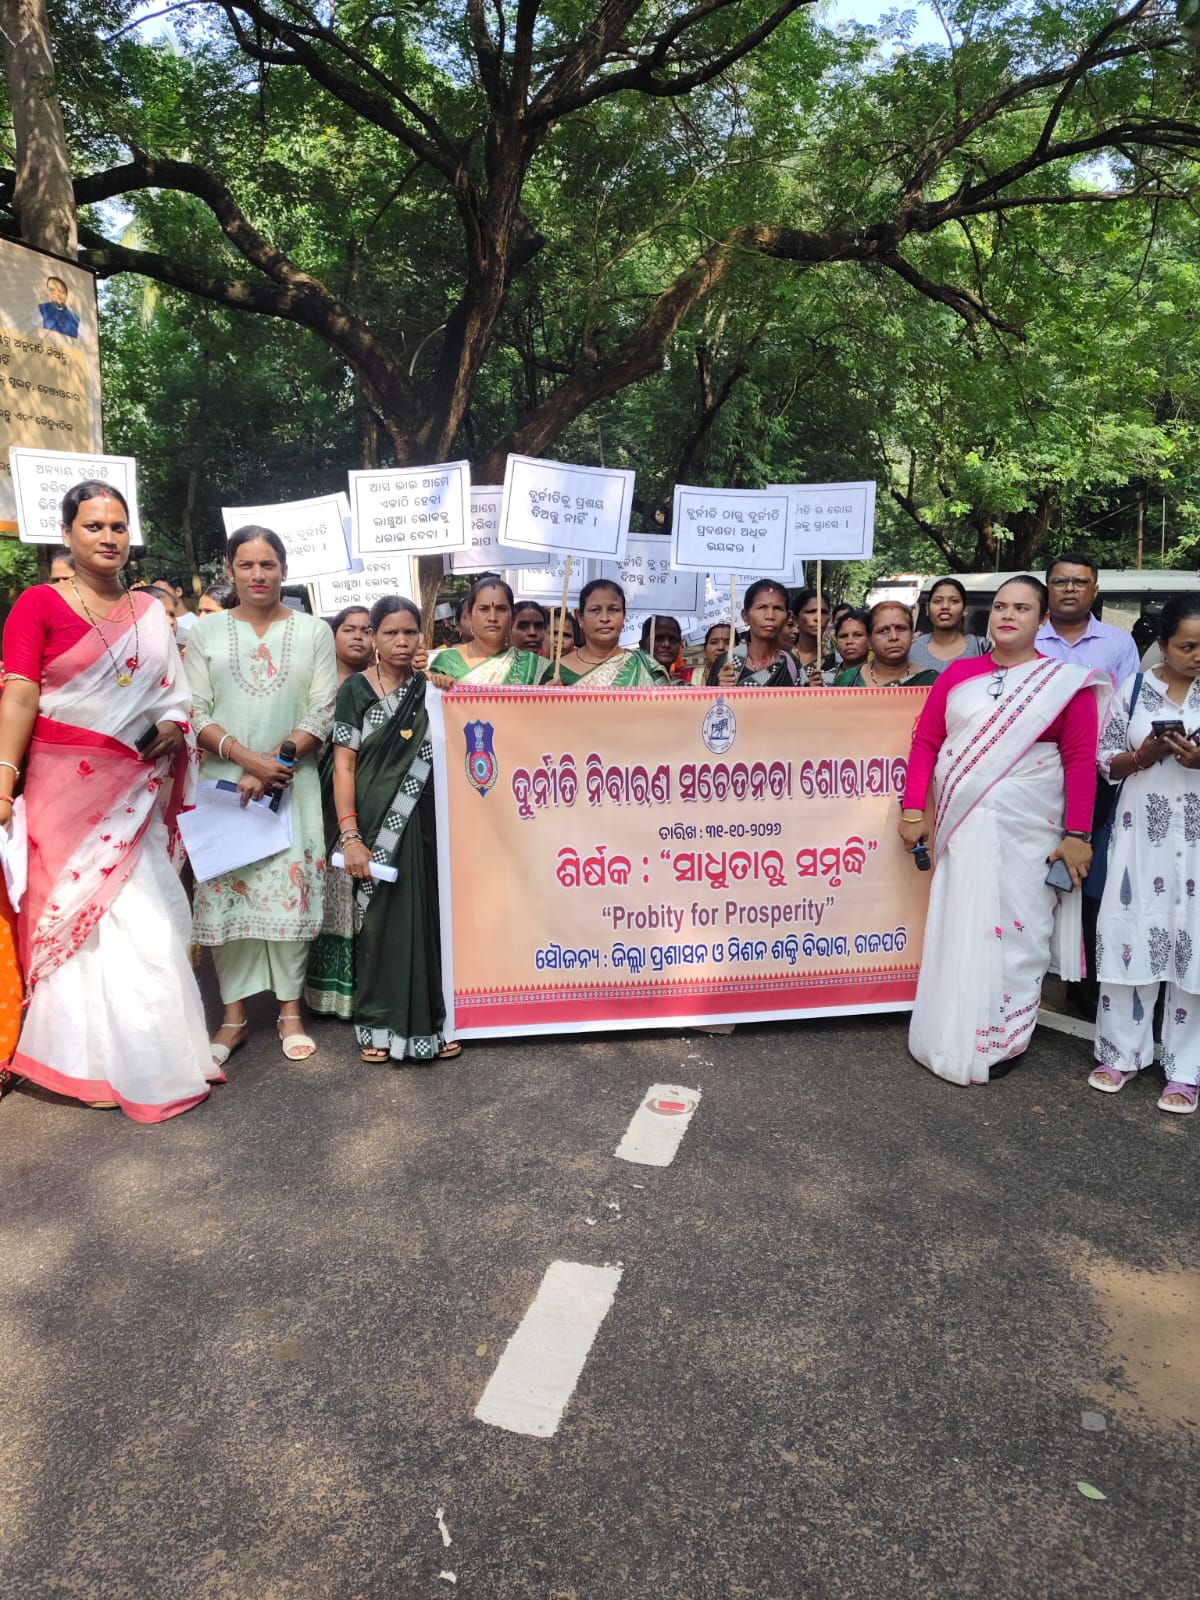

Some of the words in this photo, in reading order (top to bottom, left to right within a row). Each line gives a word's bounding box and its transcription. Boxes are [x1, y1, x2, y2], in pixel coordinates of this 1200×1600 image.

[422, 476, 449, 489] ଆମେ
[414, 494, 441, 506] ହେବା
[411, 511, 451, 524] ଲୋକକୁ
[564, 512, 588, 525] ନାହିଁ
[686, 505, 718, 520] ଦୁର୍ନୀତି
[748, 508, 780, 524] ଦୁର୍ନୀତି
[375, 532, 406, 543] ଧରାଇ
[410, 530, 438, 541] ଦେବା
[740, 527, 768, 539] ଅଧିକ
[706, 542, 744, 552] ଭୟଙ୍କର
[512, 753, 578, 817] ଦୁର୍ନୀତି
[586, 752, 672, 807] ନିବାରଣ
[678, 761, 793, 801] ସଚେତନତା
[799, 756, 908, 802] ଶୋଭାଯାତ୍ର
[556, 845, 632, 888] ଶିର୍ଷକ
[602, 904, 684, 934] “Probity
[691, 901, 719, 927] for
[725, 896, 835, 929] Prosperity”
[535, 943, 600, 970] ସୌଜନ୍ୟ
[611, 942, 647, 974] ଜିଲ୍ଲା
[650, 943, 708, 971] ପ୍ରଶାସନ
[712, 942, 724, 963] ଓ
[728, 936, 768, 962] ମିଶନ
[771, 933, 799, 966] ଶକ୍ତି
[802, 932, 851, 958] ବିଭାଗ,
[854, 926, 907, 955] ଗଜପତି
